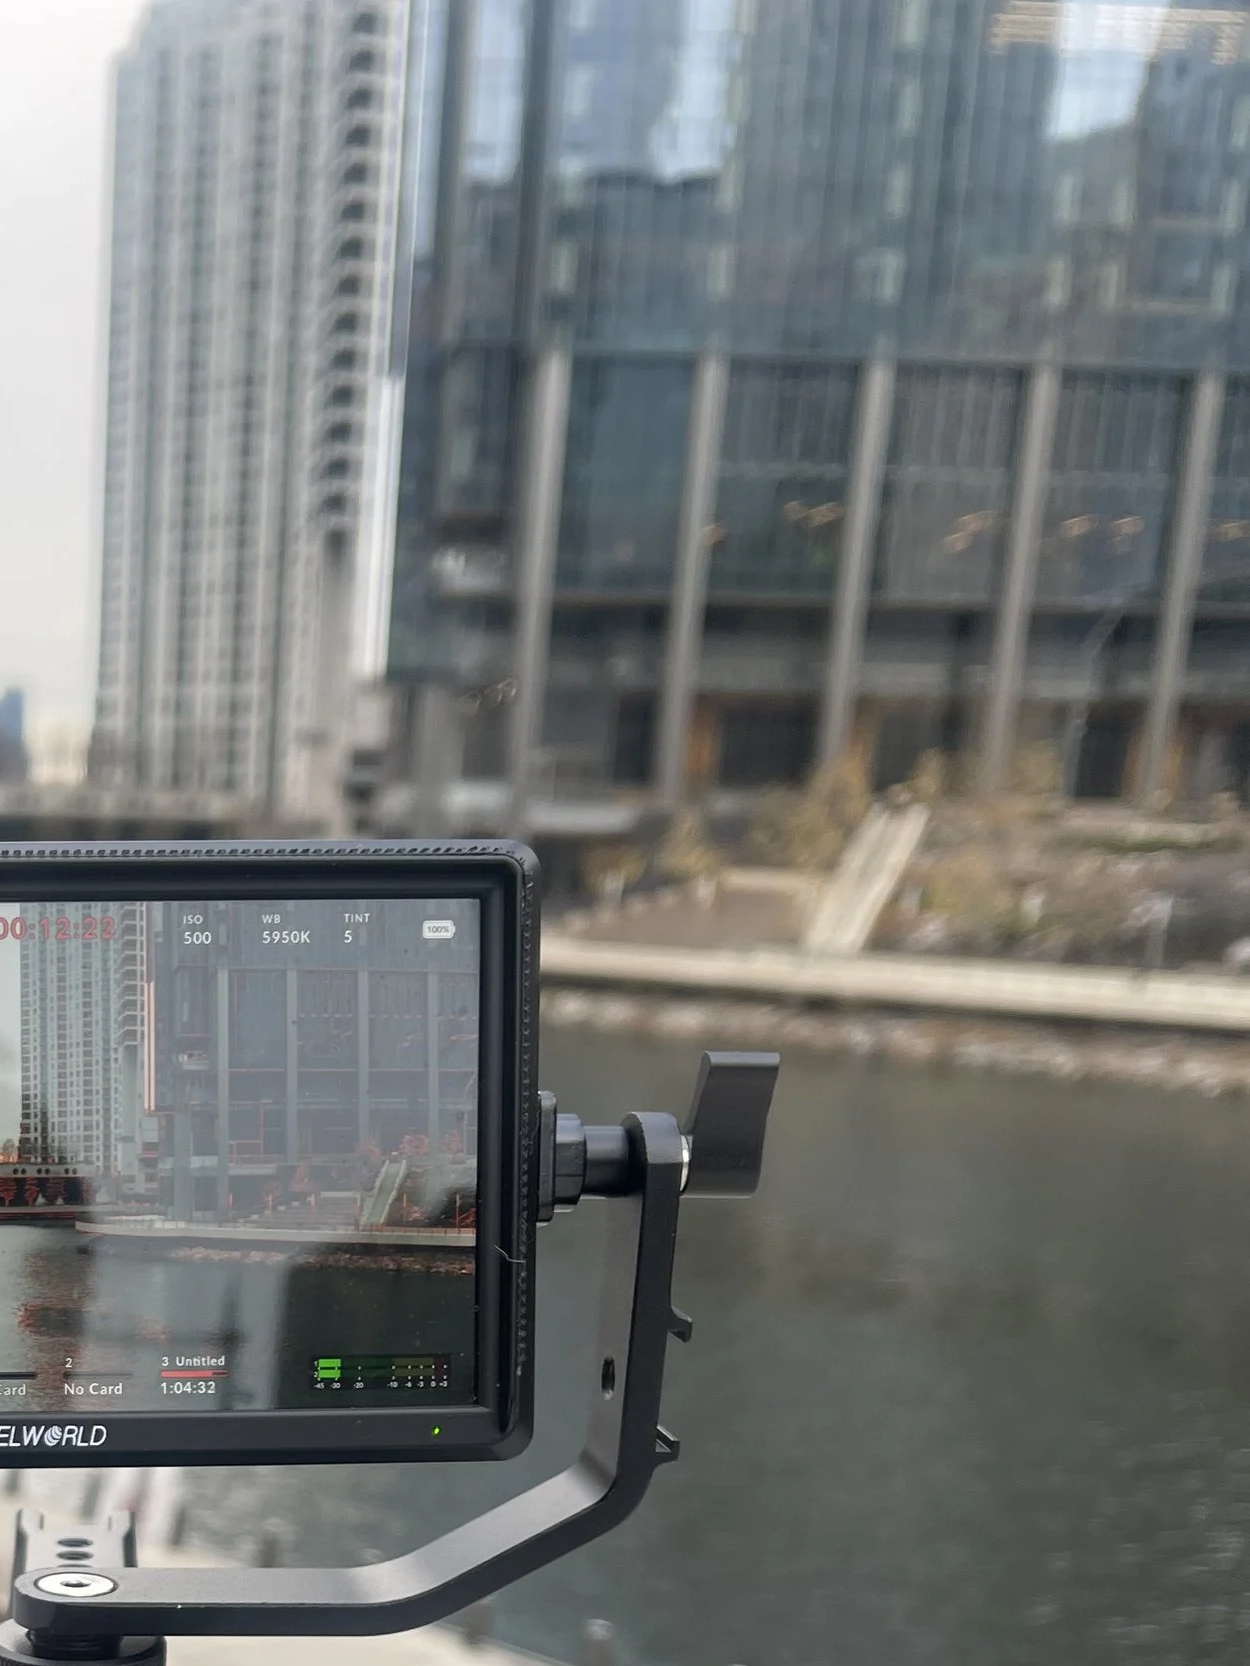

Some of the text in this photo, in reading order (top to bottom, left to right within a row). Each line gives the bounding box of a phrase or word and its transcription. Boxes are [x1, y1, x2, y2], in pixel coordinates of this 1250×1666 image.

[183, 914, 203, 925] ISO
[262, 914, 281, 924] WB
[343, 913, 371, 924] TINT
[183, 931, 212, 945] 500
[262, 930, 311, 945] 5950K
[343, 930, 353, 943] 5
[65, 1358, 73, 1368] 2
[161, 1356, 225, 1367] 3 Untitled
[64, 1383, 123, 1395] No Card
[160, 1381, 216, 1394] 1:04:32
